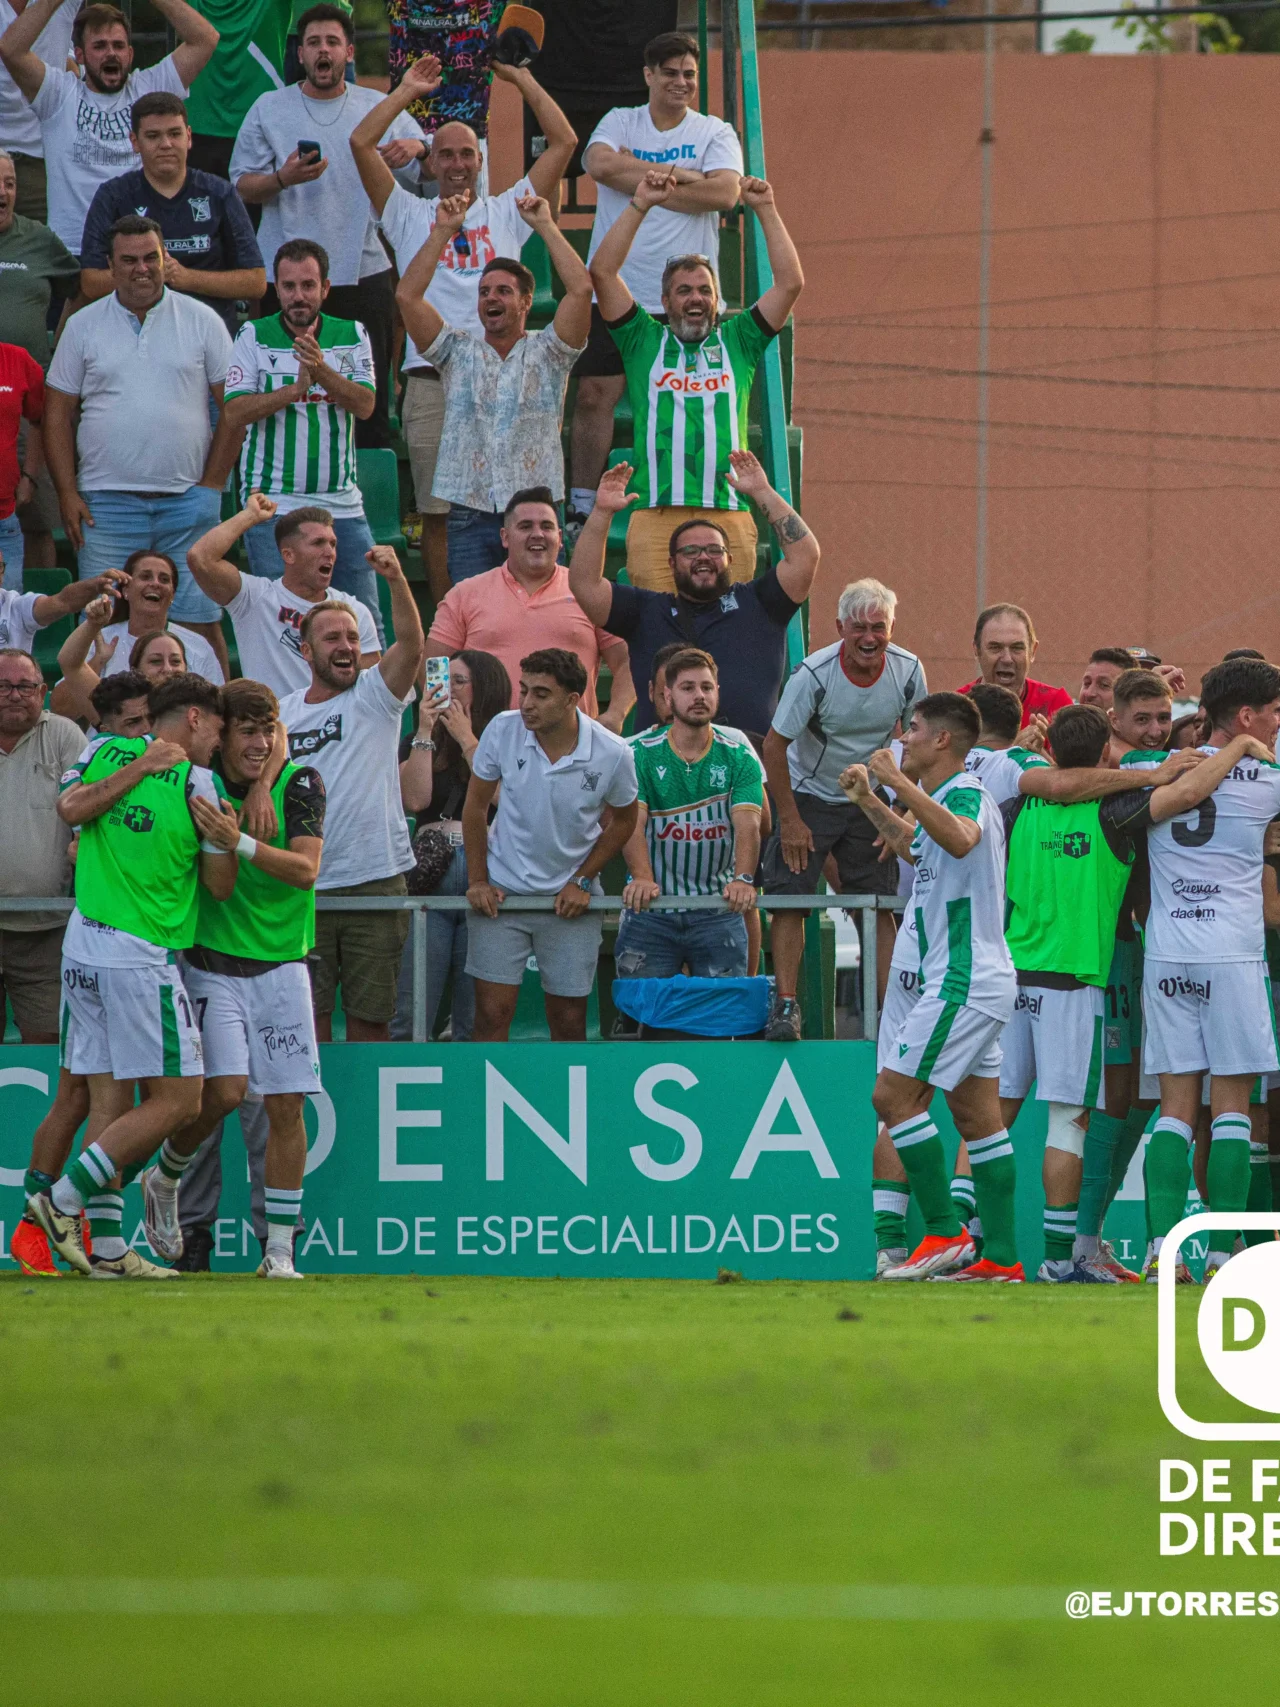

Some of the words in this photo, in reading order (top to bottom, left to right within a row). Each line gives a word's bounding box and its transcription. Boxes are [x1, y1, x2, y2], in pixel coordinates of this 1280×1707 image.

[655, 372, 730, 393] Solear
[657, 822, 727, 841] Solear
[376, 1216, 437, 1256] DE
[457, 1213, 839, 1256] ESPECIALIDADES
